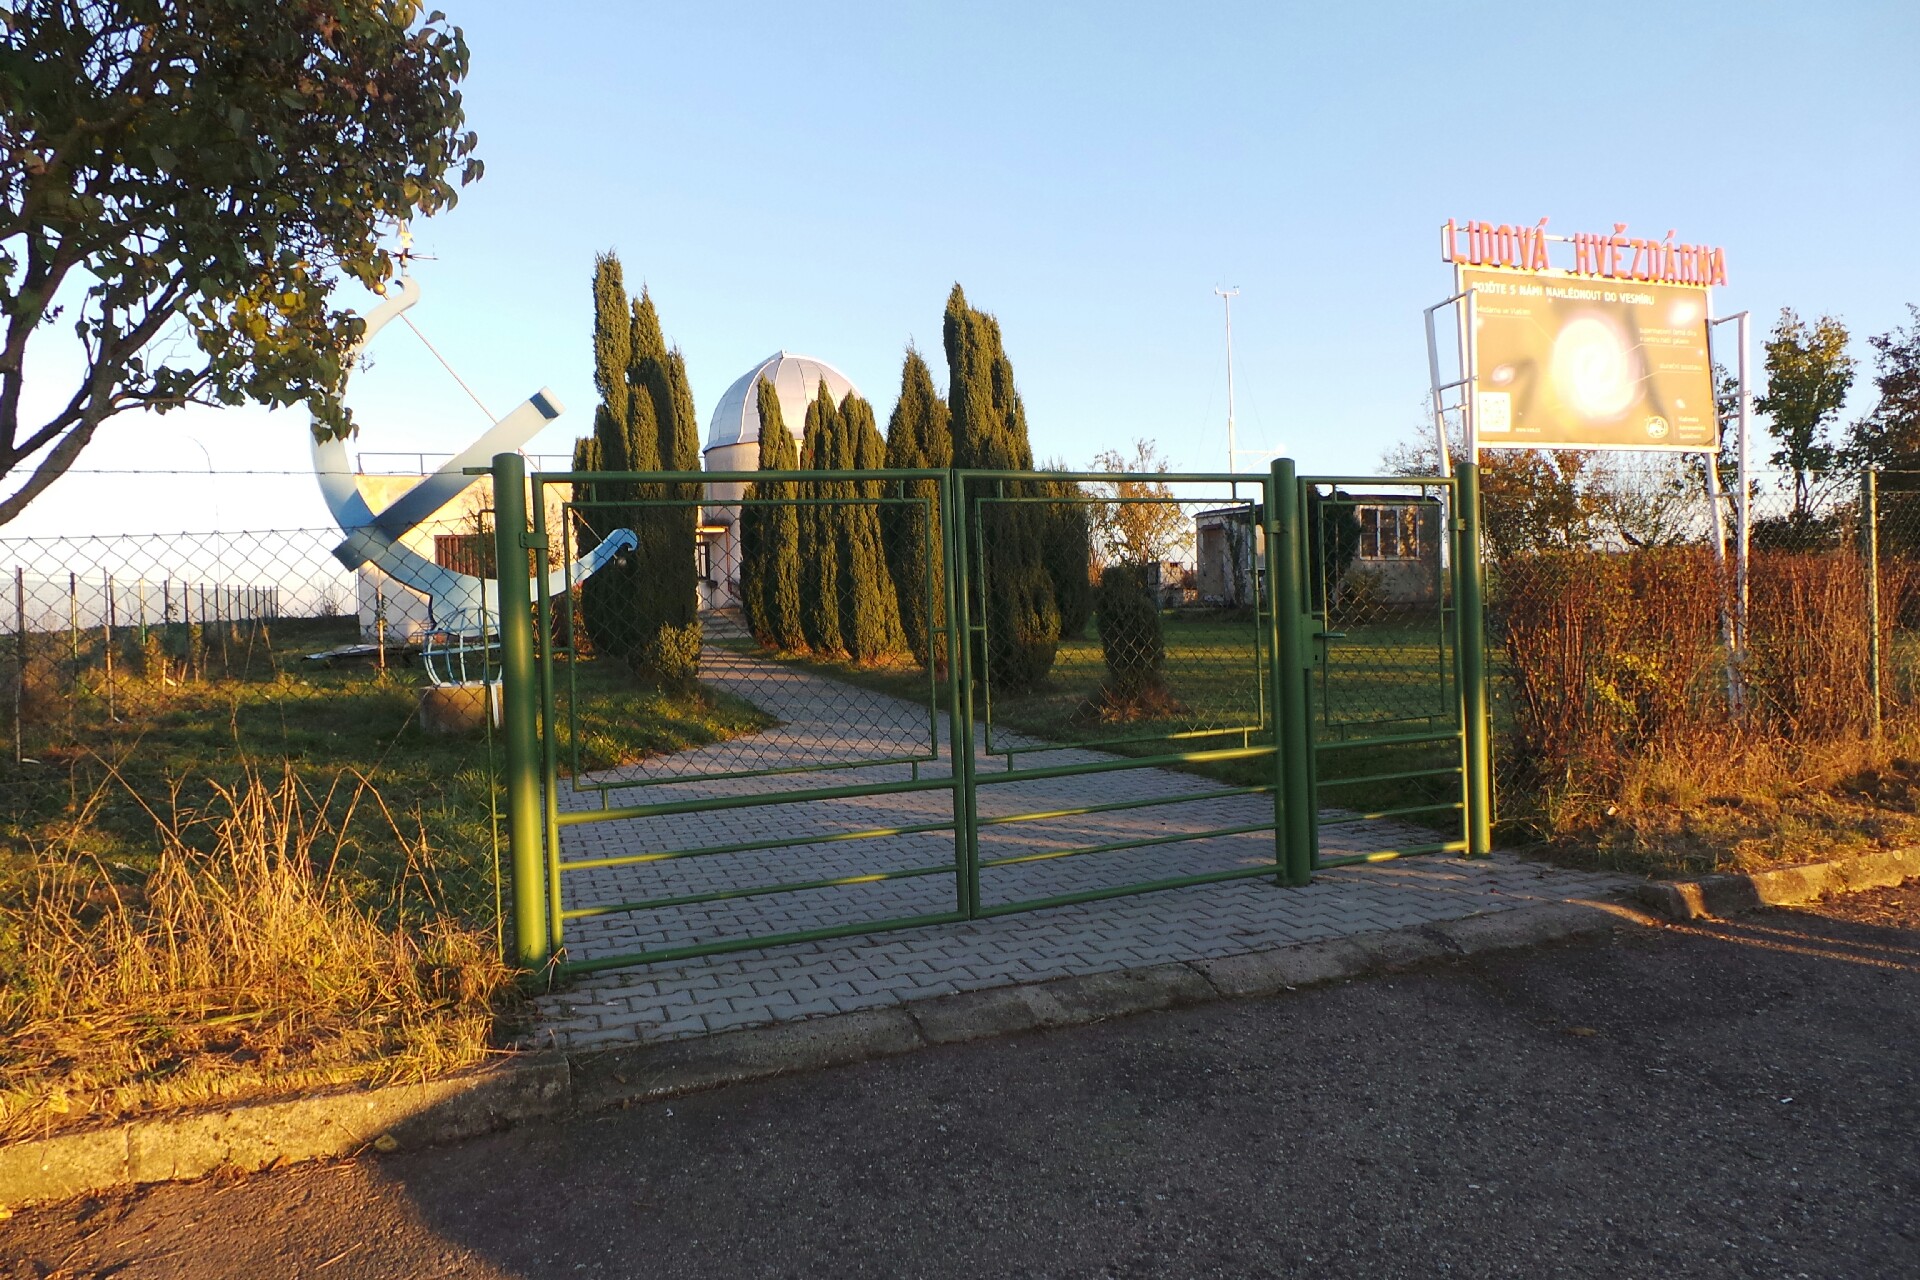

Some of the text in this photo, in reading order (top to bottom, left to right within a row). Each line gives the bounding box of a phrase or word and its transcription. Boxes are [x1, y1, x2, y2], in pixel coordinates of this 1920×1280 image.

[1448, 216, 1728, 286] LIDOVÁ HVĚZDÁRNA
[1509, 283, 1516, 296] S
[1519, 283, 1543, 296] NÁMI
[1546, 286, 1601, 301] NAHLÉDNOUT
[1604, 291, 1617, 302] DO
[1619, 292, 1655, 305] VESMÍRU
